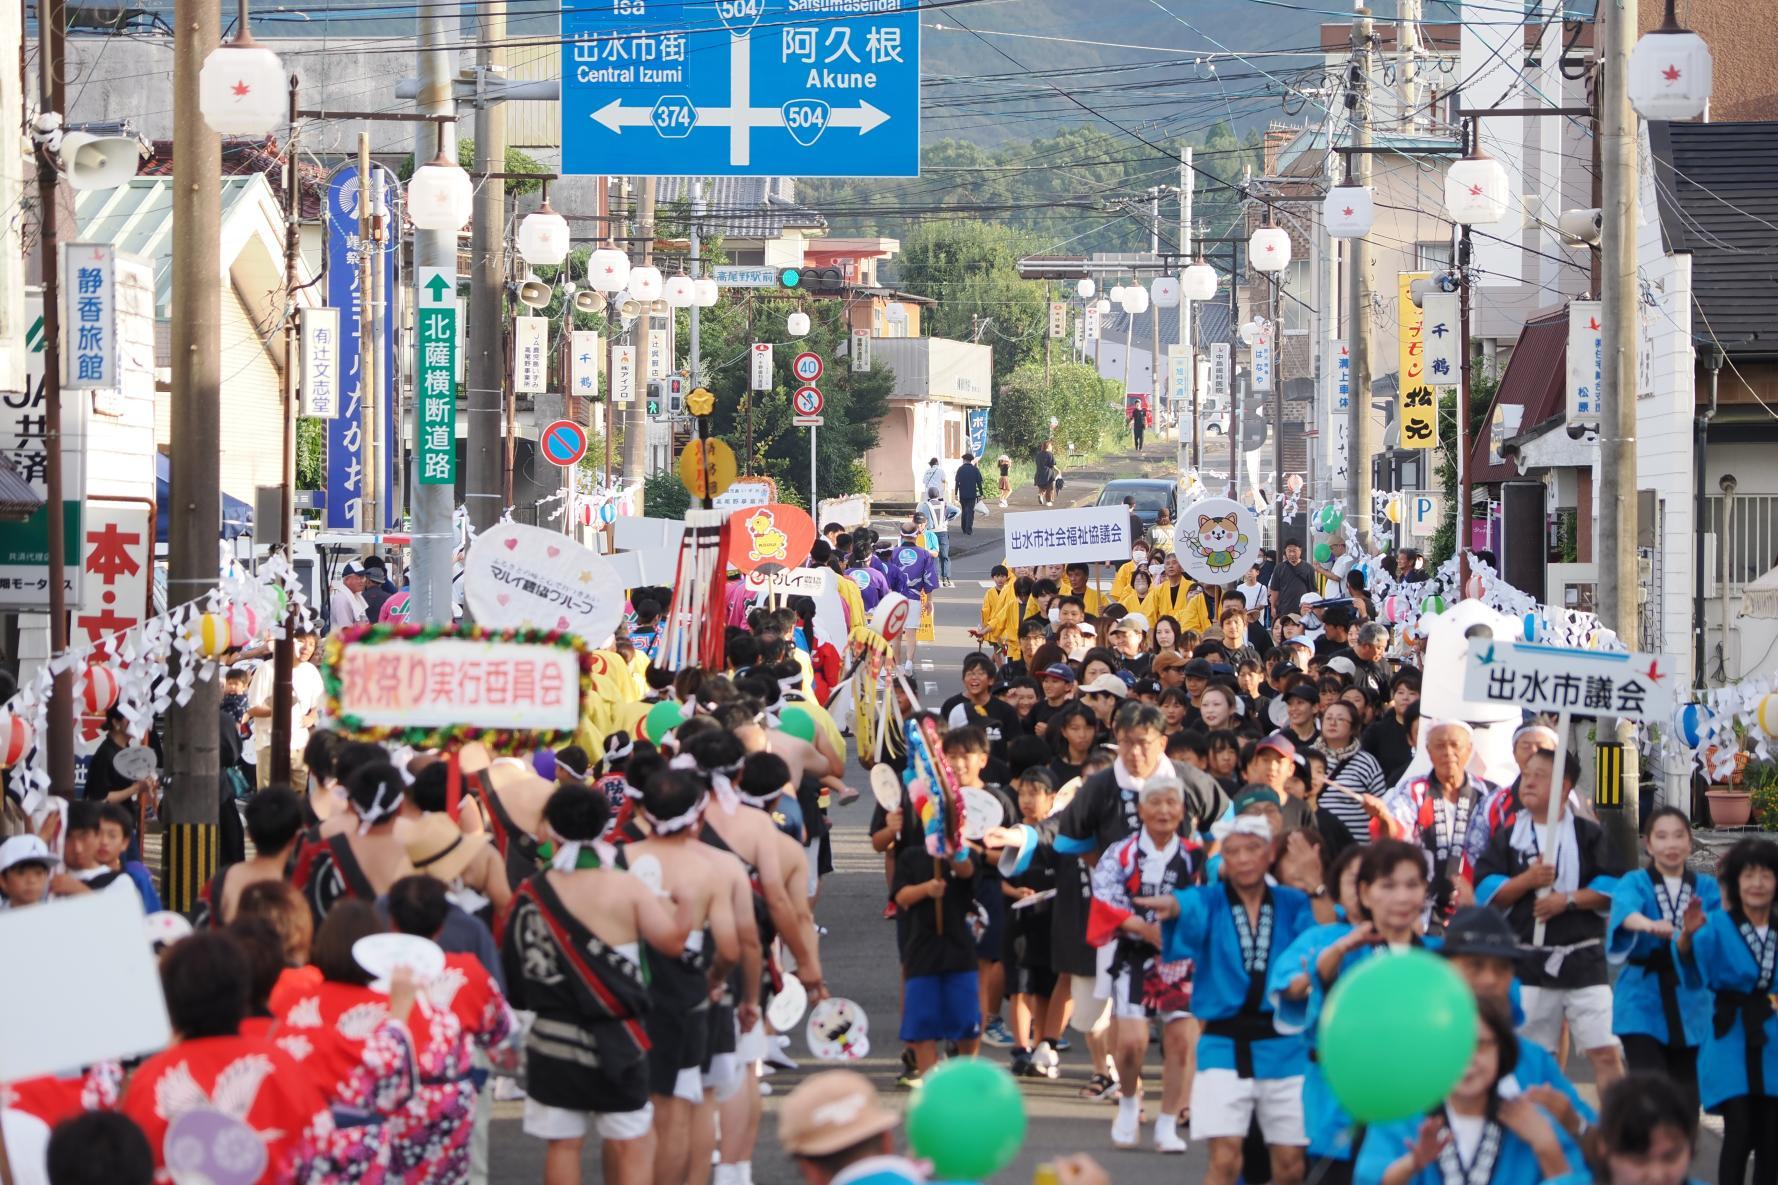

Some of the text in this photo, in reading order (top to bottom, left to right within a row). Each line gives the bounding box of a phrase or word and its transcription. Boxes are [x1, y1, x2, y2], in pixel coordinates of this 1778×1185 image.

[613, 0, 645, 15] Isa
[722, 0, 757, 18] 504
[574, 29, 686, 63] 出水市街
[782, 27, 904, 64] 阿久根
[577, 66, 682, 84] Central Izumi
[806, 69, 877, 89] Akune
[657, 106, 690, 128] 374
[788, 107, 823, 128] 504
[716, 270, 774, 284] 高尾野駅前
[77, 266, 104, 381] 静香旅館
[1431, 322, 1451, 377] 千鶴
[578, 352, 593, 389] 千鶴
[800, 361, 817, 374] 40
[1255, 350, 1265, 385] はなや
[424, 314, 451, 480] 北薩横断道路
[1577, 386, 1590, 412] 松原
[1403, 385, 1433, 440] 松元
[1417, 498, 1432, 522] P
[1010, 522, 1123, 551] 出水市社会福祉協議会
[0, 577, 73, 591] 畑モータス
[489, 564, 596, 615] マルイ農協グループ
[343, 653, 564, 708] 秋祭り実行委員会
[1486, 666, 1648, 715] 出水市議会
